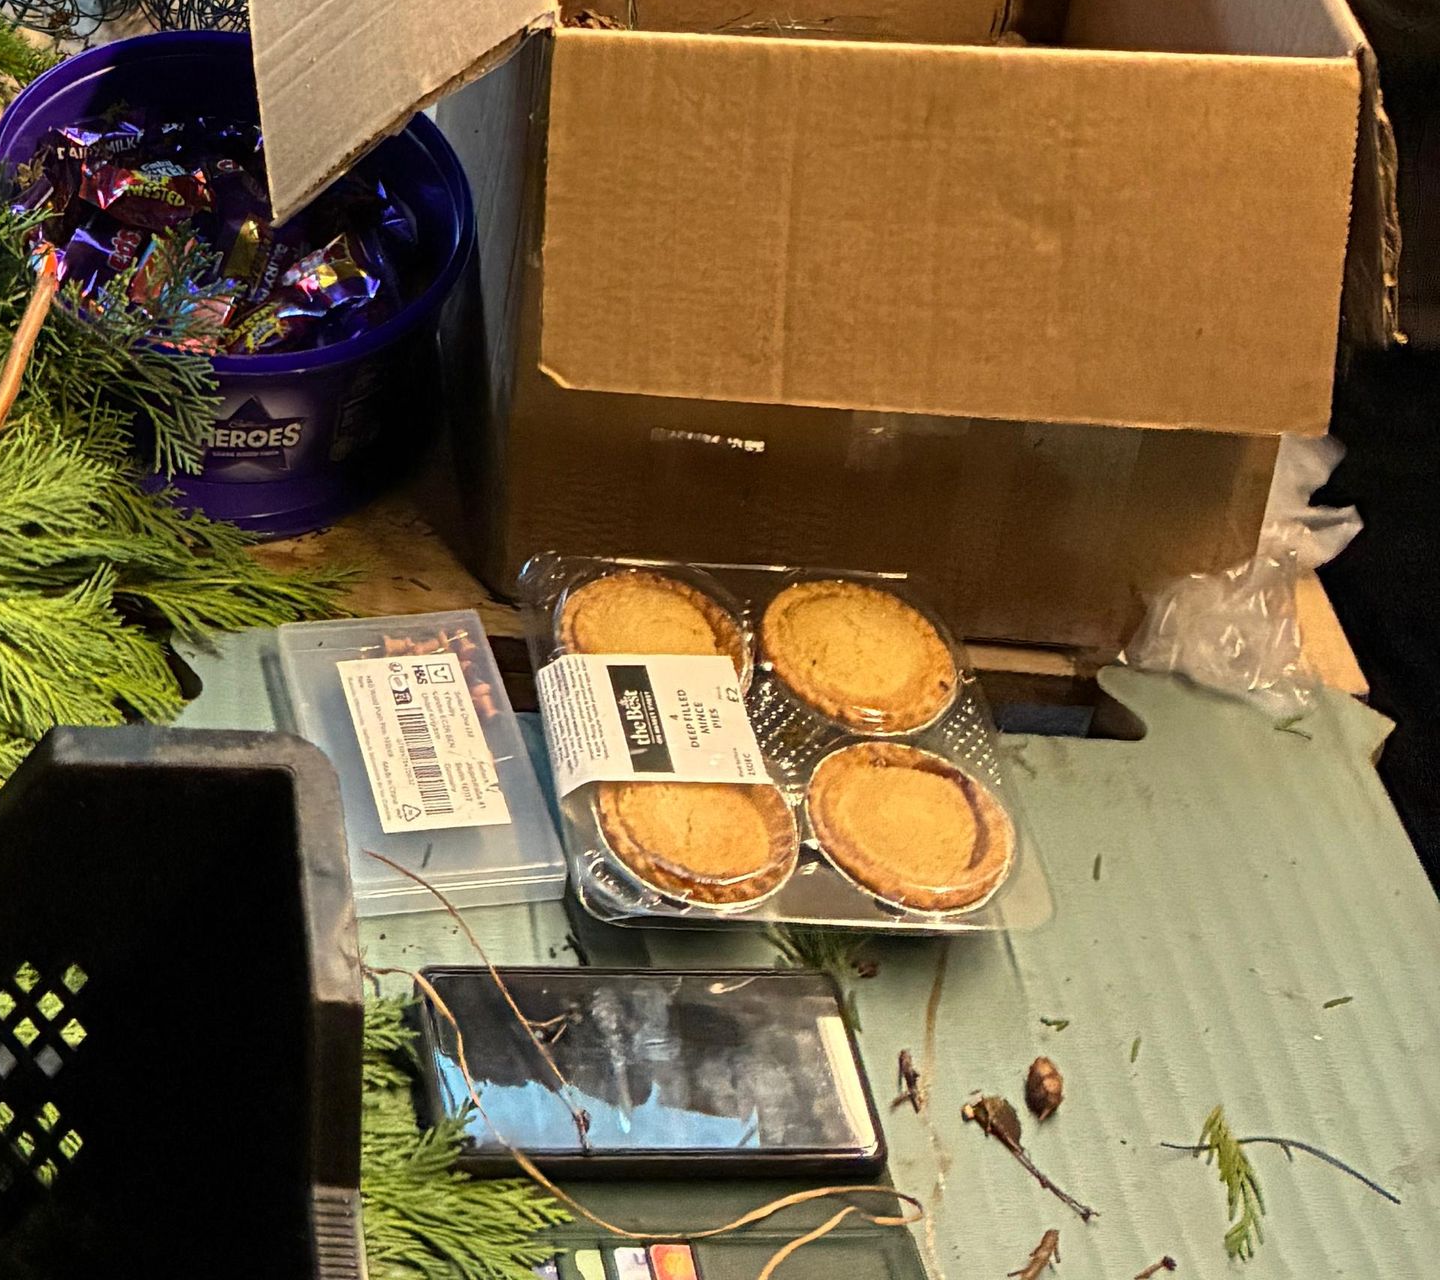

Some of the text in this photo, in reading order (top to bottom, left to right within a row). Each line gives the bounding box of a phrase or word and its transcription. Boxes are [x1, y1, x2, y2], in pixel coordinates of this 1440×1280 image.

[104, 136, 138, 154] MILK
[200, 422, 303, 449] HEROES
[724, 687, 740, 703] £2
[623, 690, 652, 744] the Best
[675, 689, 700, 747] DEEP FILLED
[692, 701, 710, 734] MINCE
[708, 708, 722, 728] PIES
